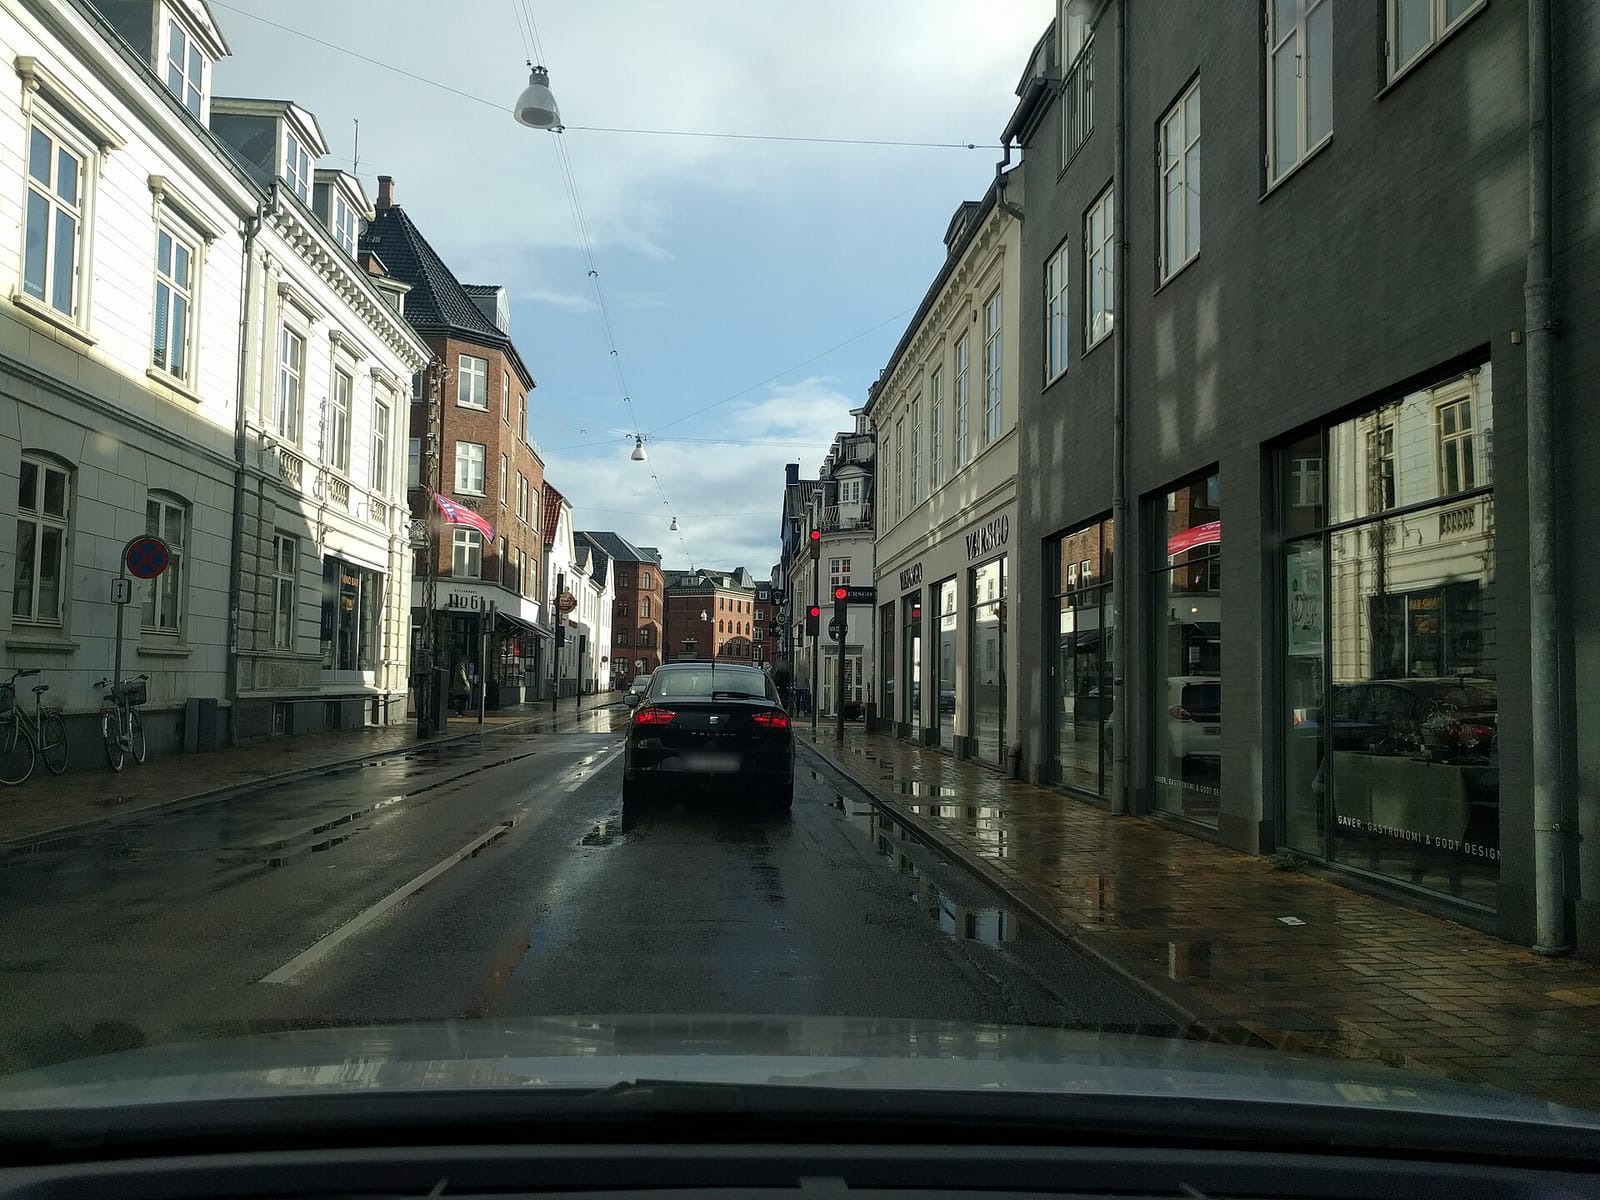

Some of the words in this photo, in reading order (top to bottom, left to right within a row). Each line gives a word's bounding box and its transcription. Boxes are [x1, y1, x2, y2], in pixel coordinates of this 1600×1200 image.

[1337, 815, 1365, 831] GAVER,
[1367, 821, 1421, 843] GASTRONOMI
[1425, 834, 1431, 845] &
[1435, 837, 1461, 852] GODT
